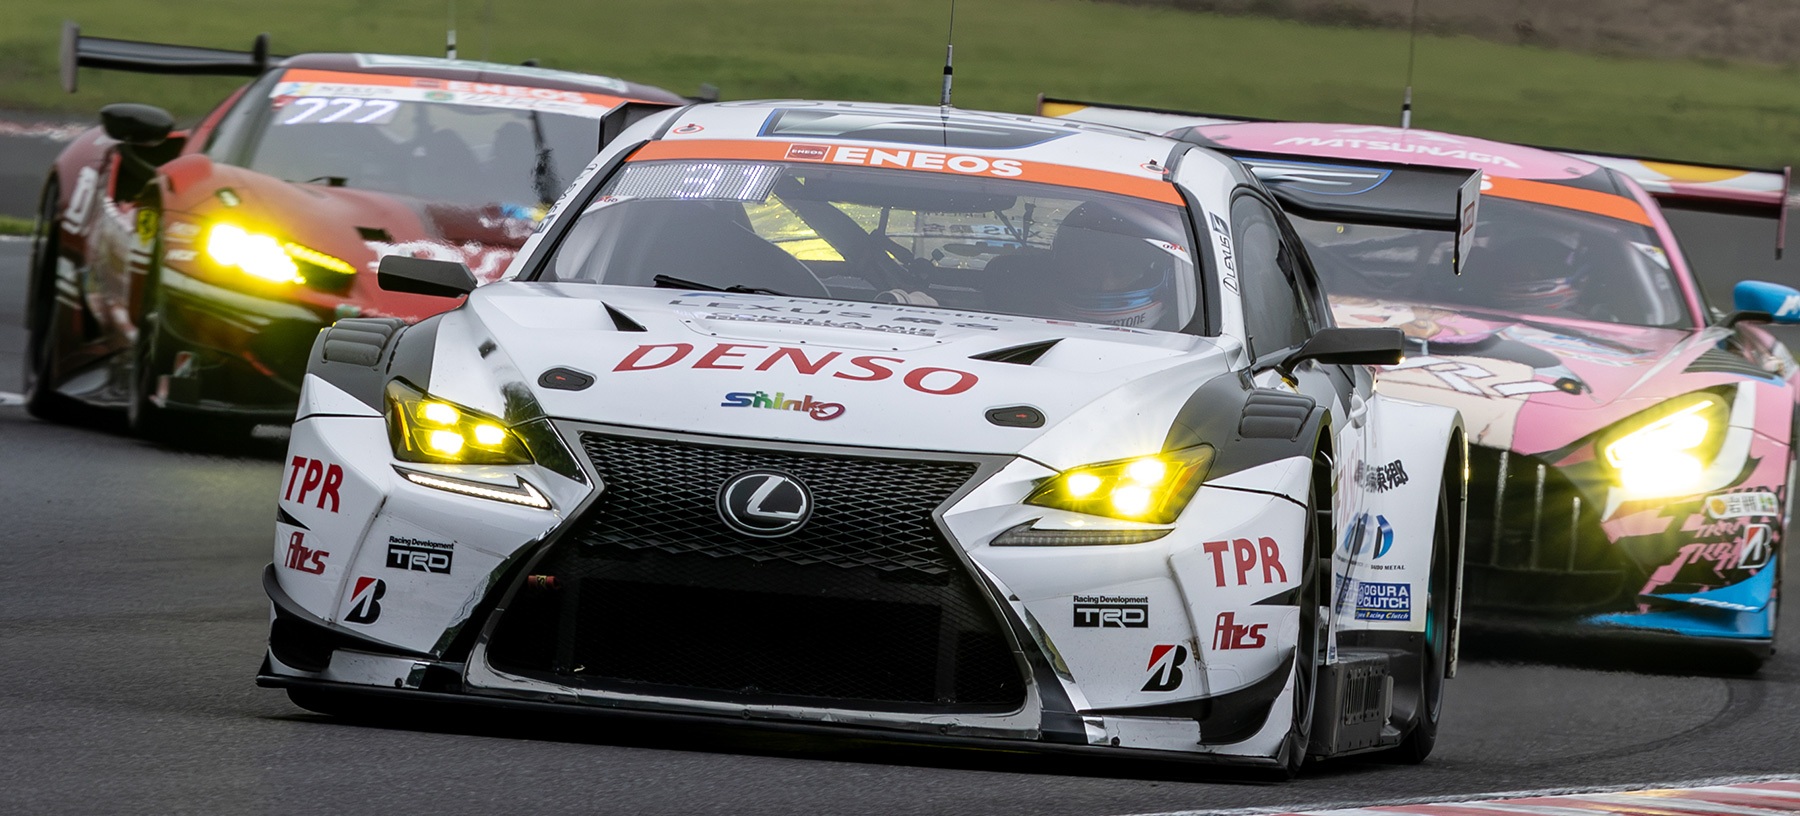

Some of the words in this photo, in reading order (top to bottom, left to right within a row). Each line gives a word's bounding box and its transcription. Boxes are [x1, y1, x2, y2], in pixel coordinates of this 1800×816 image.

[284, 97, 400, 124] 777
[833, 146, 1023, 177] ENEOS
[1274, 136, 1522, 169] MATSUNAGA
[612, 343, 979, 395] DENSO
[285, 455, 343, 513] TPR
[389, 536, 411, 547] Racing
[411, 538, 454, 550] Development
[390, 548, 449, 573] TRD
[1203, 536, 1288, 587] TPR
[1073, 595, 1099, 604] Racing
[1100, 595, 1148, 604] Development
[1363, 596, 1410, 609] CLUTCH
[1364, 584, 1409, 597] OGURA
[1076, 608, 1145, 629] TRD
